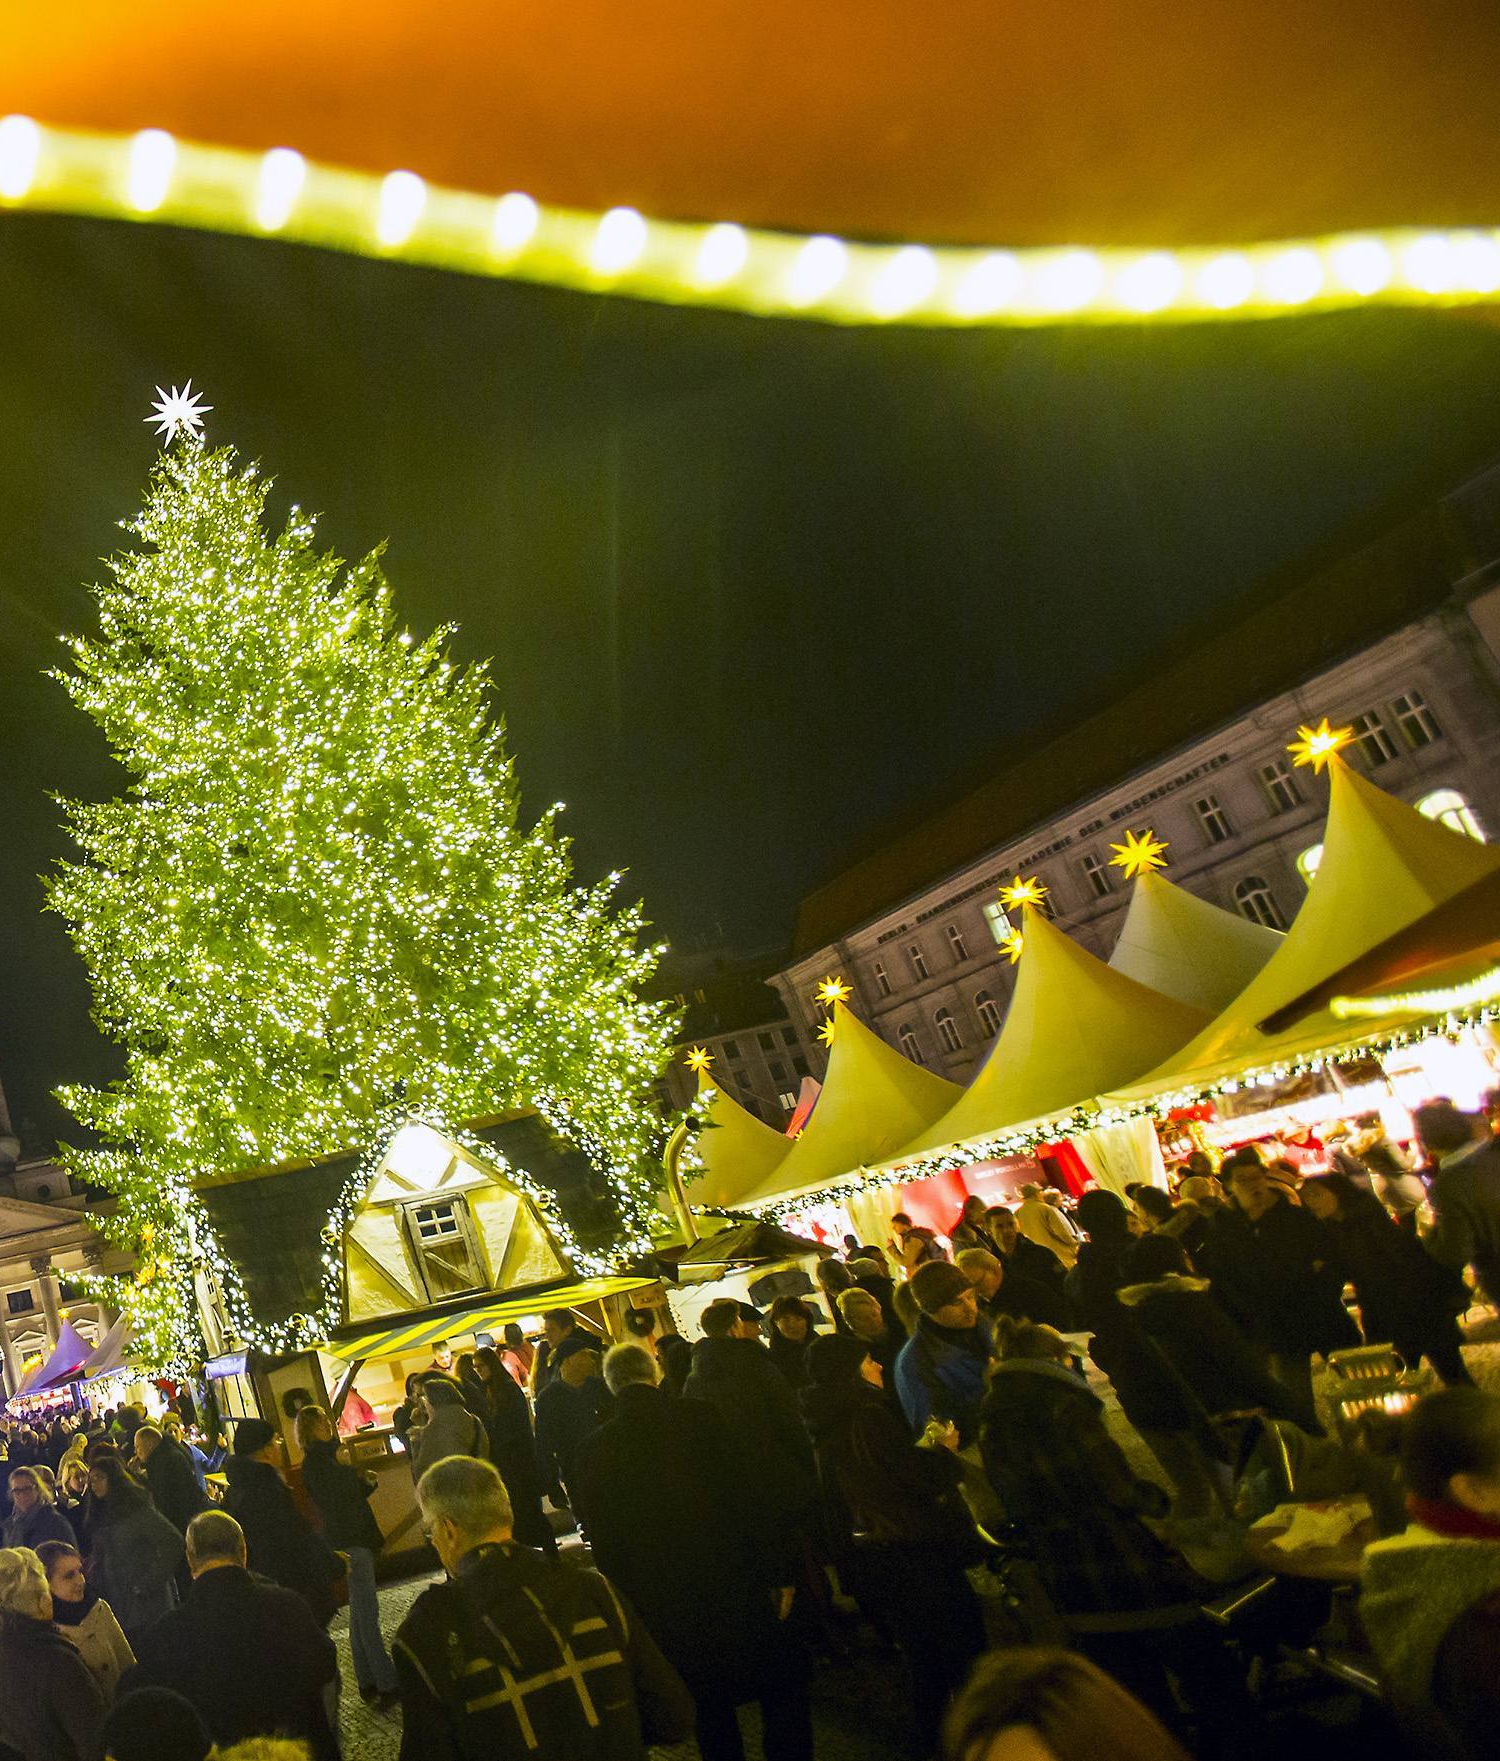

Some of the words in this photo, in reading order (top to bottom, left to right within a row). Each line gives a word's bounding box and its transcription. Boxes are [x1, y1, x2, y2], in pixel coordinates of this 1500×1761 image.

[1018, 836, 1072, 870] AKADEMIE
[1079, 820, 1104, 838] DER
[1109, 753, 1230, 821] WISSENSCHAFTEN
